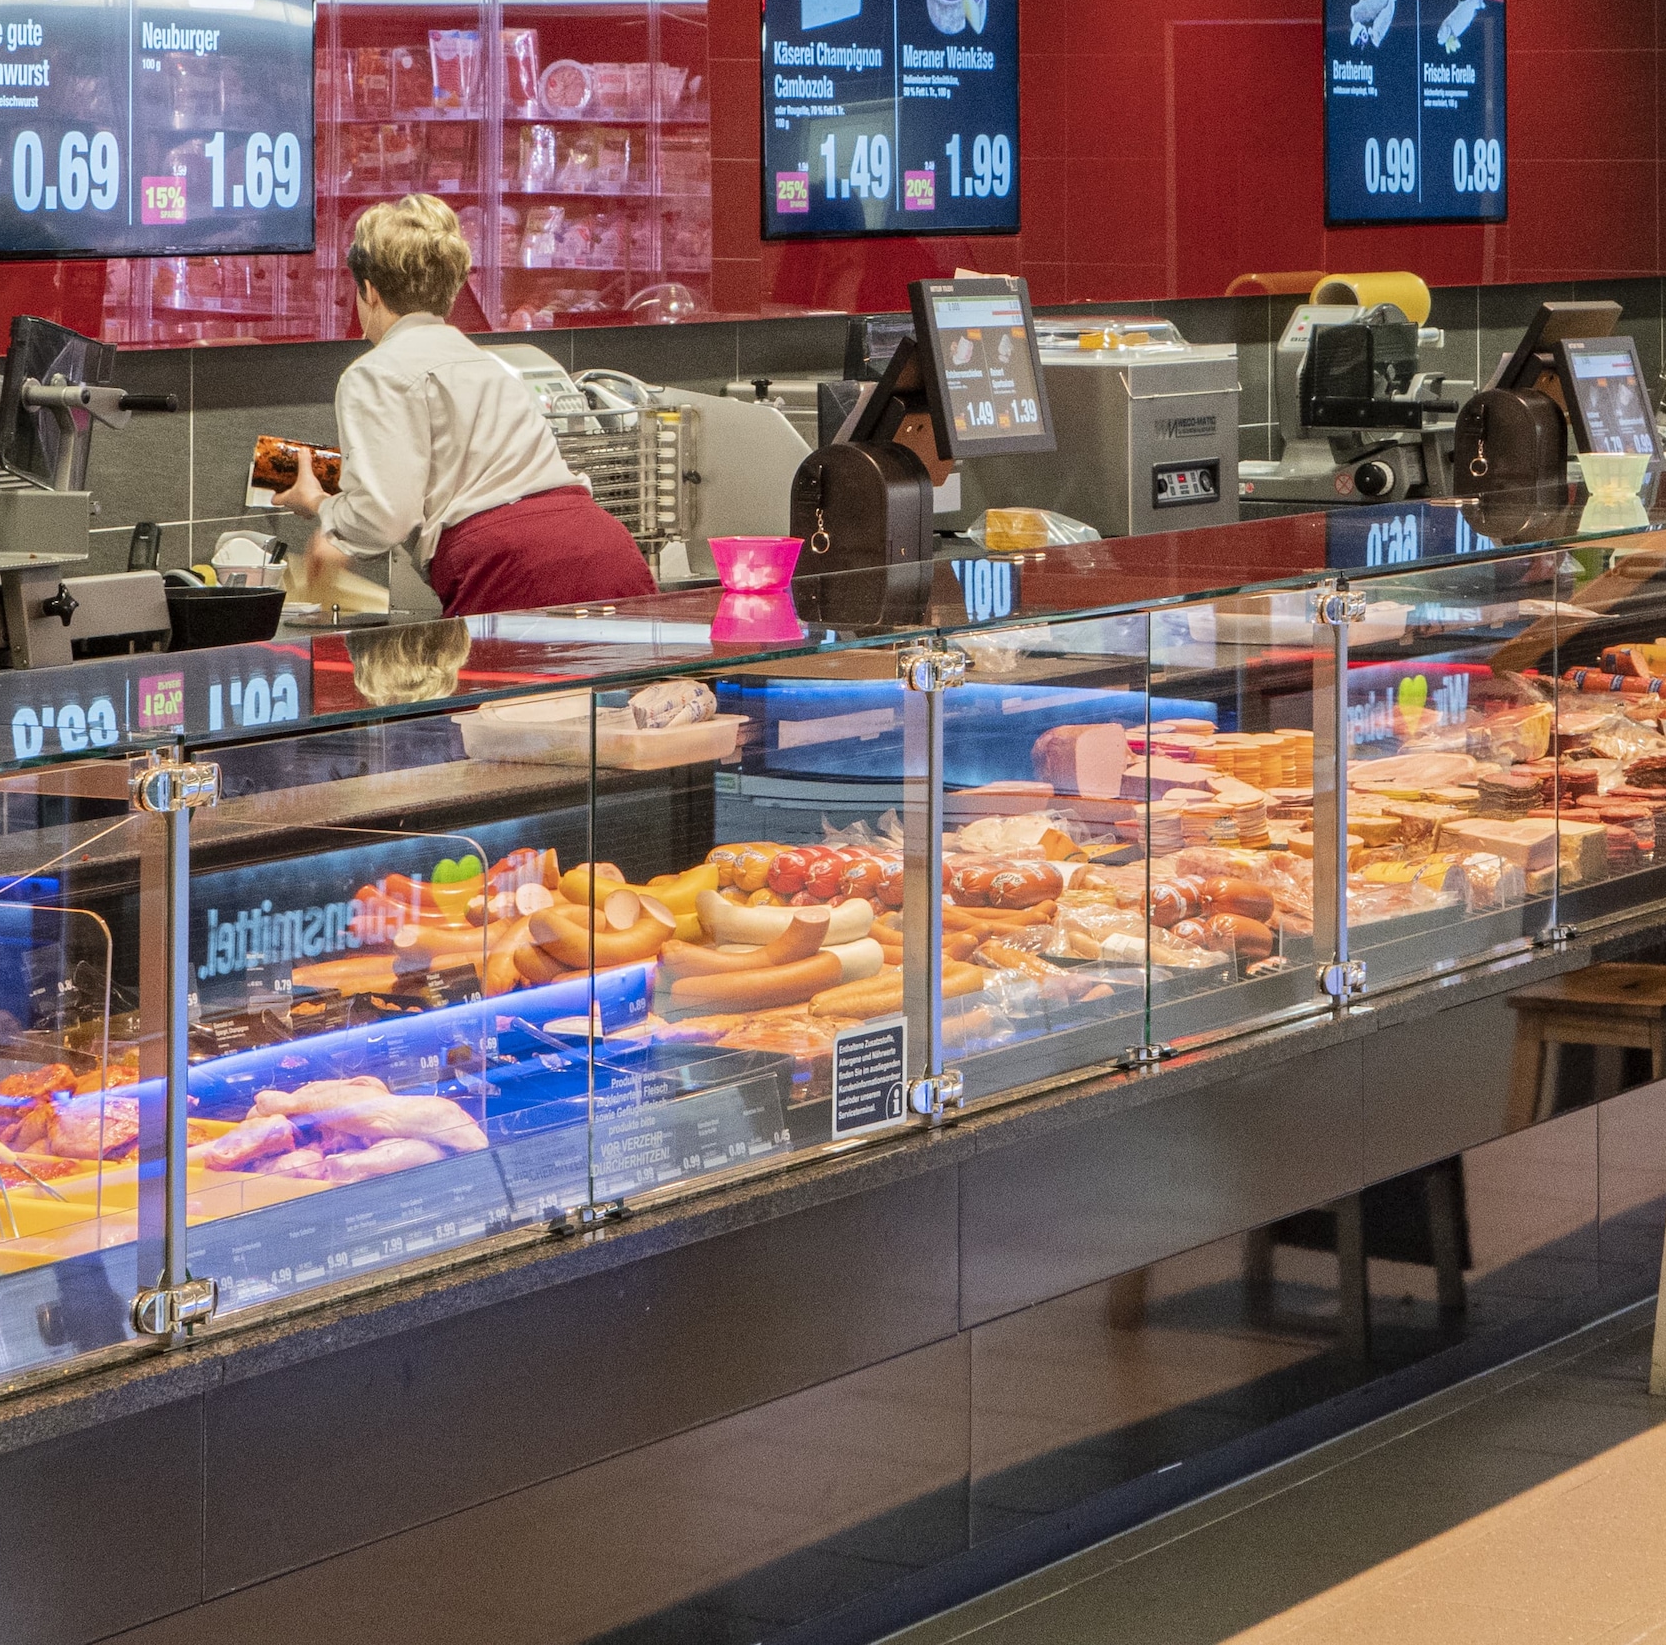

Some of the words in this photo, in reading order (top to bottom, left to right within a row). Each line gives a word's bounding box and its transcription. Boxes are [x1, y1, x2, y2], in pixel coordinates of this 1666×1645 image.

[7, 19, 43, 51] gute
[142, 22, 220, 57] Neuburger
[142, 58, 155, 70] 100
[774, 41, 814, 65] Käserei
[817, 42, 882, 72] Champignon
[903, 44, 945, 68] Meraner
[946, 46, 994, 69] Weinkäse
[1333, 60, 1373, 85] Brathering
[1424, 62, 1450, 83] Frische
[1451, 64, 1475, 83] Forelle
[775, 74, 833, 98] Cambozola
[13, 131, 119, 212] 0.69
[205, 131, 301, 209] 1.69
[821, 133, 891, 199] 1.49
[946, 133, 1010, 197] 1.99
[1365, 138, 1415, 193] 0.99
[1453, 138, 1501, 192] 0.89
[145, 187, 186, 210] 15%
[778, 180, 807, 199] 25%
[906, 179, 933, 197] 20%
[967, 401, 994, 427] 1.49
[1011, 398, 1038, 423] 1.39
[862, 1052, 871, 1062] und
[644, 1082, 669, 1097] Fleisch
[601, 1141, 621, 1157] VOR
[621, 1130, 663, 1152] VERZEHR
[271, 1267, 292, 1285] 4.99
